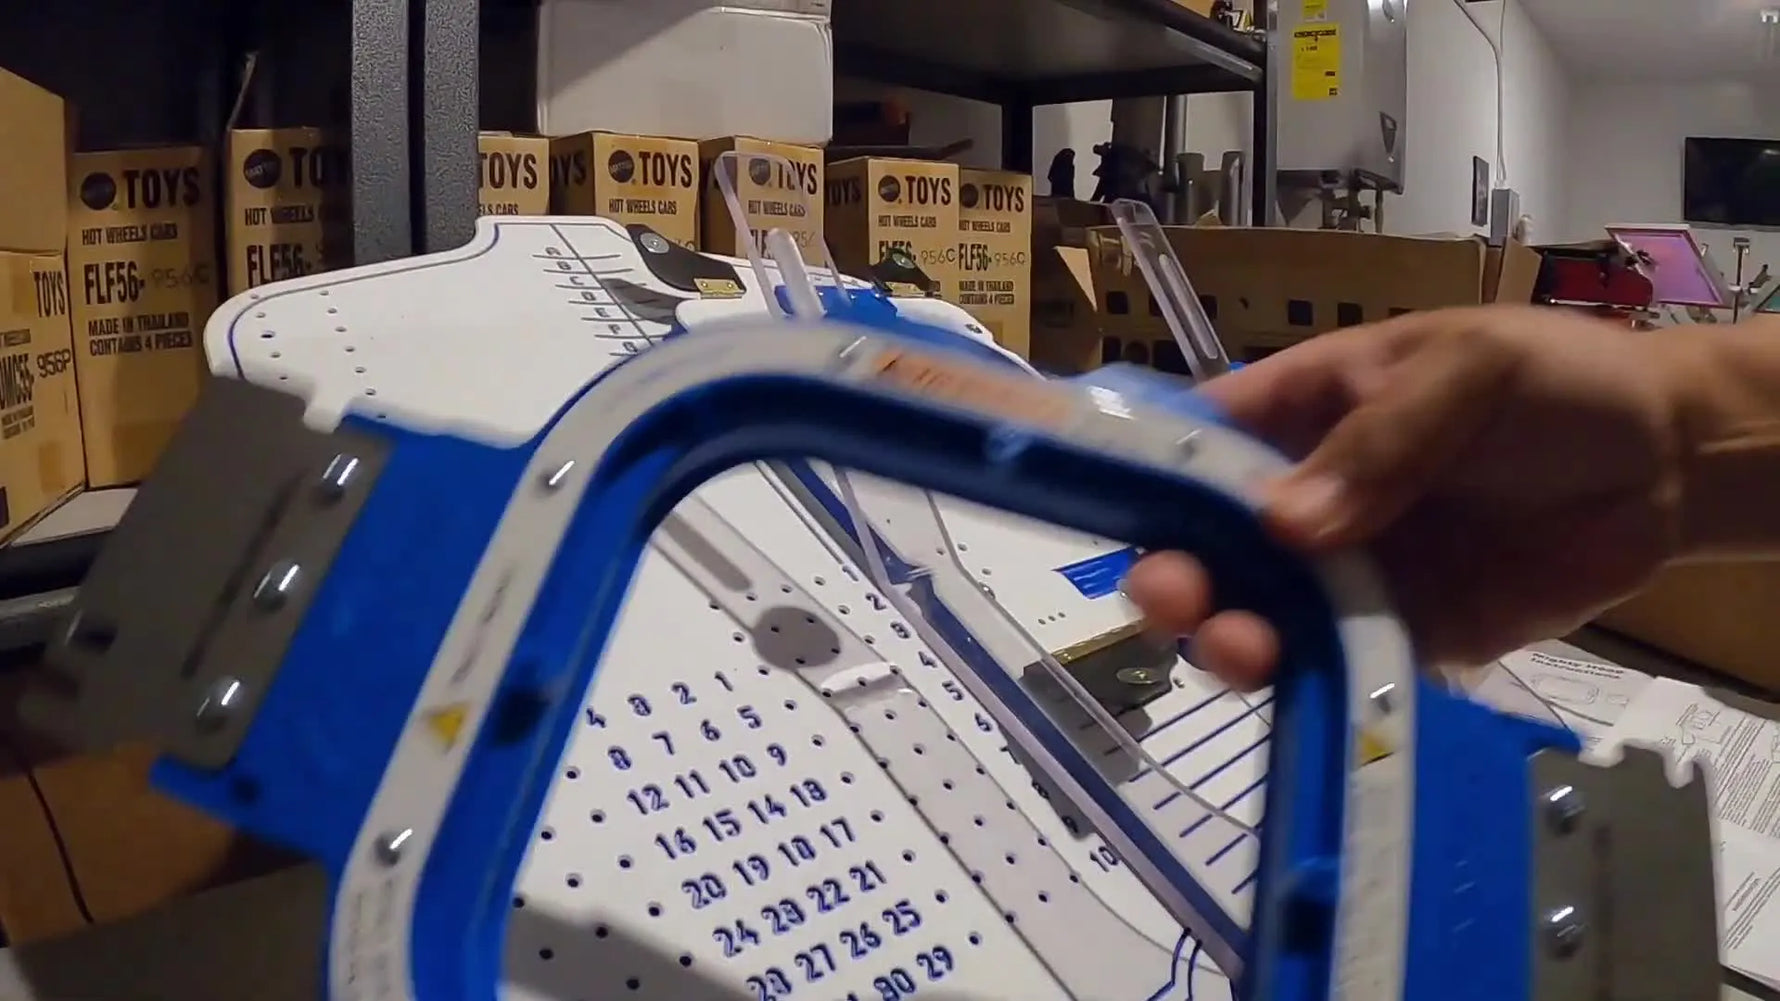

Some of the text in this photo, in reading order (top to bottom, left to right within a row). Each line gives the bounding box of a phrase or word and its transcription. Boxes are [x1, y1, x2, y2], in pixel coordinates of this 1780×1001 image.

[289, 146, 348, 188] TO
[479, 152, 537, 189] TOYS
[639, 151, 692, 188] TOYS
[777, 159, 817, 195] TOYS
[123, 167, 200, 209] TOYS
[905, 176, 951, 205] TOYS
[983, 184, 1024, 212] TOYS
[245, 208, 266, 225] HOT
[609, 199, 677, 215] HOT WHEELS CARS
[82, 228, 102, 245] HOT
[105, 224, 147, 243] WHEELS
[921, 248, 956, 265] 956C
[33, 271, 65, 318] TOYS
[88, 312, 189, 336] MADE IN THAILAND
[89, 331, 193, 356] CONTAINS 4 PIECES
[37, 349, 70, 378] 956P
[866, 592, 887, 611] 2
[918, 651, 937, 668] 4
[586, 707, 607, 728] 4
[671, 682, 697, 704] 2
[715, 671, 733, 691] 1
[942, 681, 964, 701] 5
[652, 731, 675, 755] 7
[701, 719, 721, 741] 6
[737, 705, 762, 729] 5
[974, 712, 993, 732] 6
[627, 743, 787, 815] 12 11 10 9
[655, 827, 697, 859] 16
[703, 809, 741, 842] 15
[747, 794, 787, 824] 14
[681, 873, 727, 909] 20
[733, 854, 770, 885] 19
[820, 816, 855, 848] 17
[1089, 846, 1119, 873] 10
[712, 919, 760, 957] 24
[806, 878, 851, 912] 22
[849, 860, 887, 892] 21
[794, 943, 837, 982] 27
[839, 922, 881, 958] 26
[882, 899, 922, 935] 25
[917, 945, 953, 981] 29
